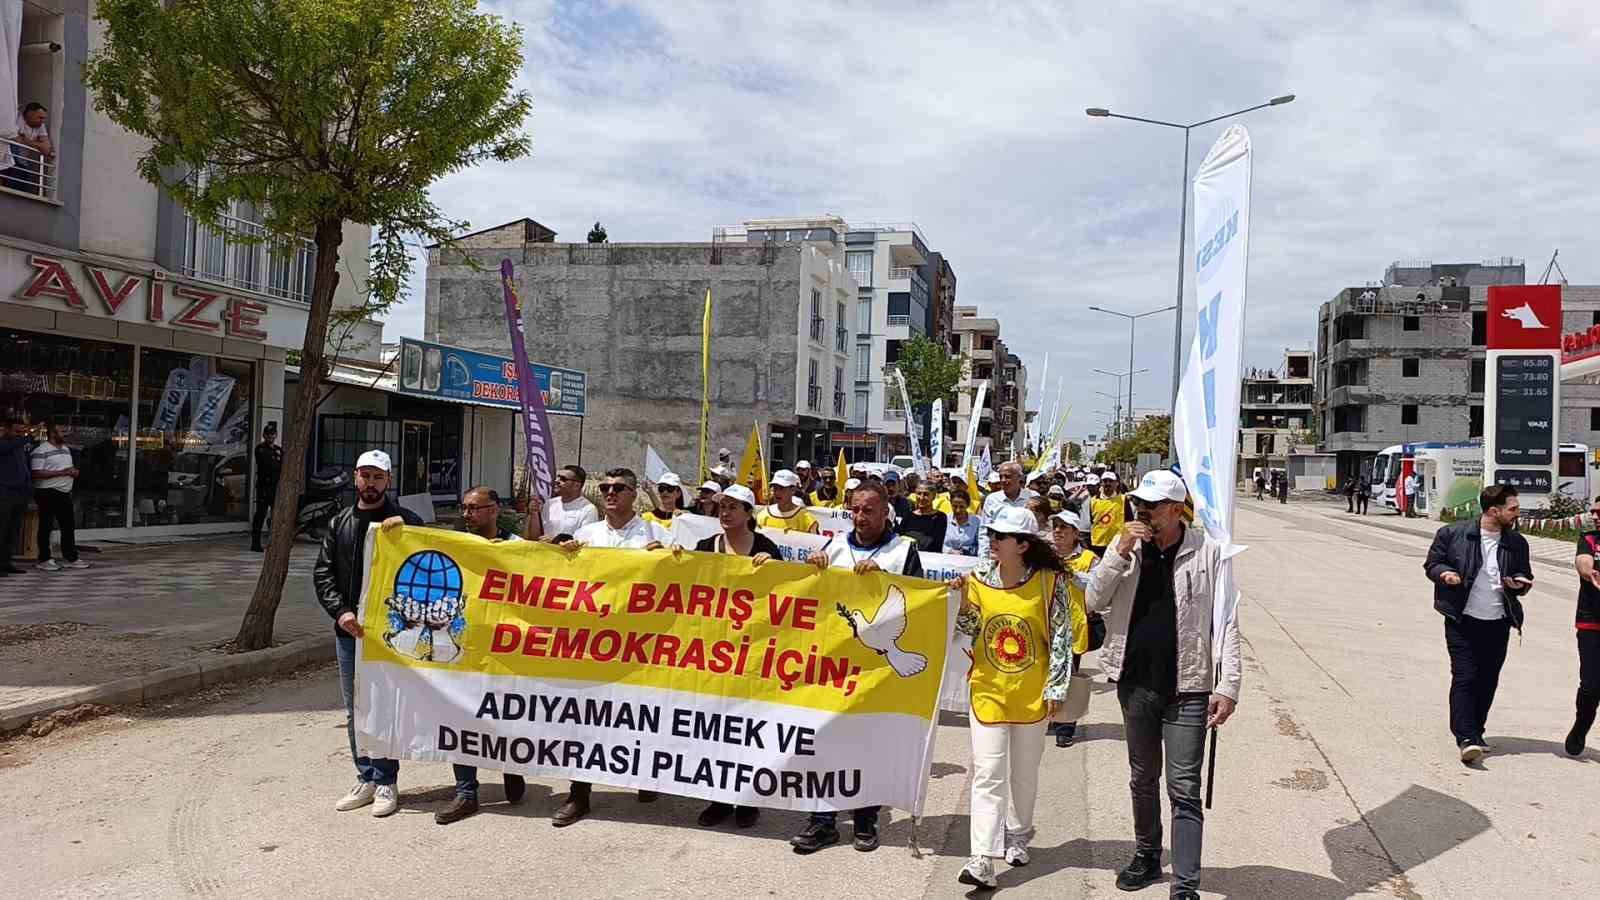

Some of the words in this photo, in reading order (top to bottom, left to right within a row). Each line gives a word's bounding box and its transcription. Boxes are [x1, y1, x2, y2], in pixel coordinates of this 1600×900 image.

[21, 254, 268, 340] AVİZE
[478, 569, 612, 618] EMEK,
[627, 583, 755, 630] BARIŞ
[768, 593, 820, 631] VE
[490, 624, 750, 676] DEMOKRASİ
[760, 638, 861, 697] İÇİN;
[475, 691, 661, 733] ADIYAMAN
[671, 708, 768, 749] EMEK
[776, 723, 816, 756] VE
[438, 725, 641, 776] DEMOKRASİ
[651, 750, 861, 799] PLATFORMU
